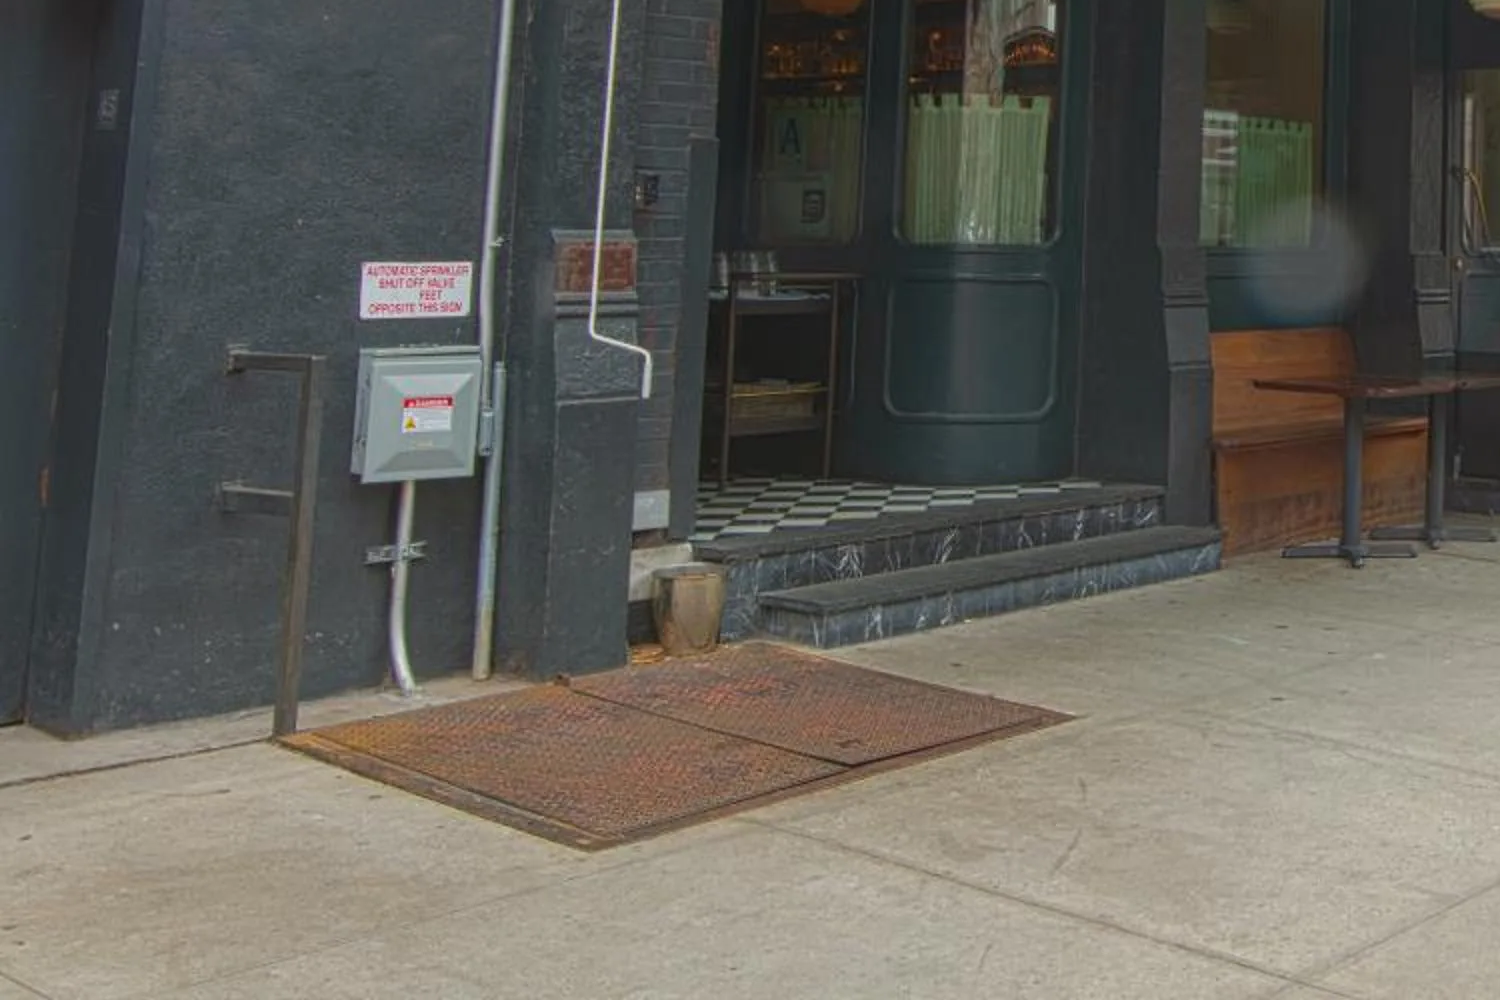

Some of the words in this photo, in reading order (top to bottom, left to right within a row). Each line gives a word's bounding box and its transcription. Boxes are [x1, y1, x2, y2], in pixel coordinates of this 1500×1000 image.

[779, 117, 801, 154] A
[367, 265, 417, 276] AUTOMATIC
[418, 264, 470, 275] SPRINKLER
[379, 278, 405, 289] SHUT
[406, 278, 425, 288] OFF
[428, 277, 455, 289] VALVE
[419, 289, 443, 300] FEET
[368, 303, 416, 314] OPPOSITE
[418, 302, 438, 313] THIS
[438, 302, 462, 312] SIGN
